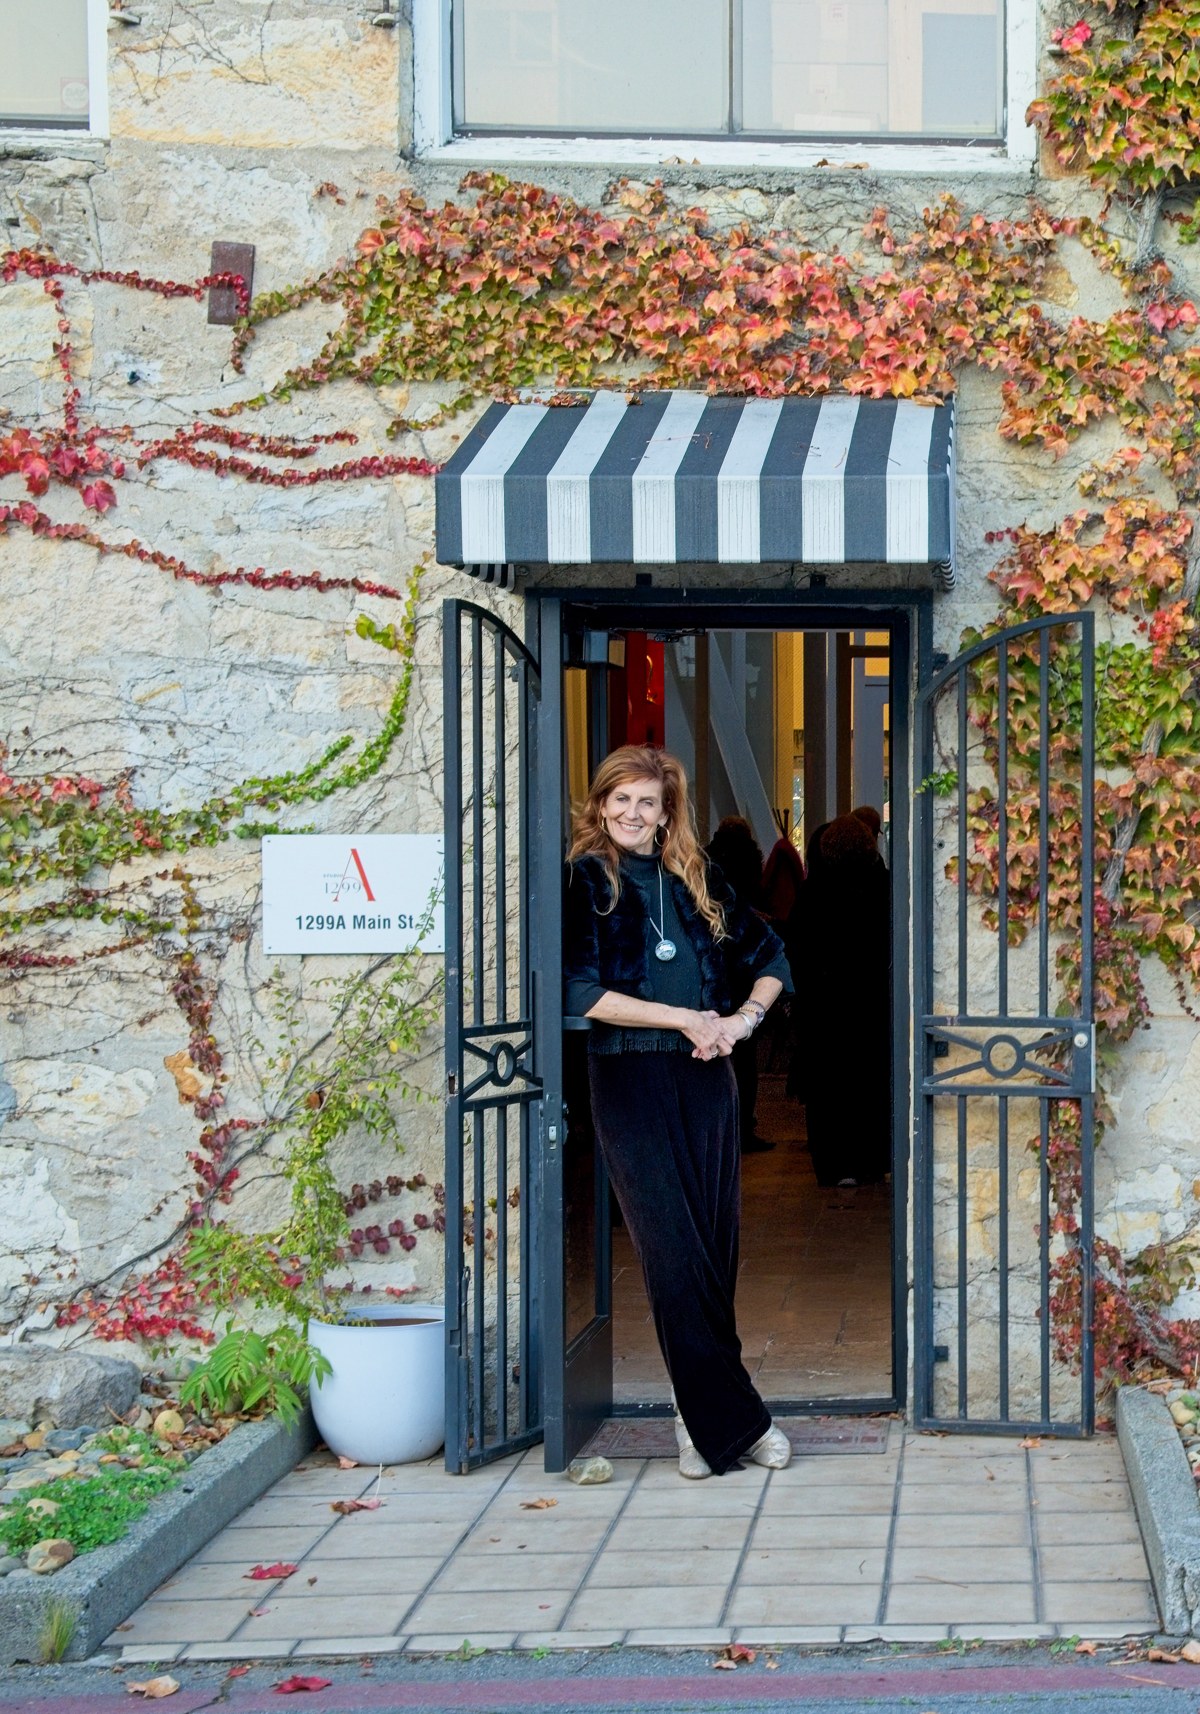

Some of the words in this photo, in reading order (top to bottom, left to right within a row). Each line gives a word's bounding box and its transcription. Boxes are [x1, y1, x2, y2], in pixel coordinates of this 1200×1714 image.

[325, 882, 361, 894] 1299
[295, 914, 346, 930] 1299A
[352, 914, 391, 930] Main
[398, 914, 413, 930] St
